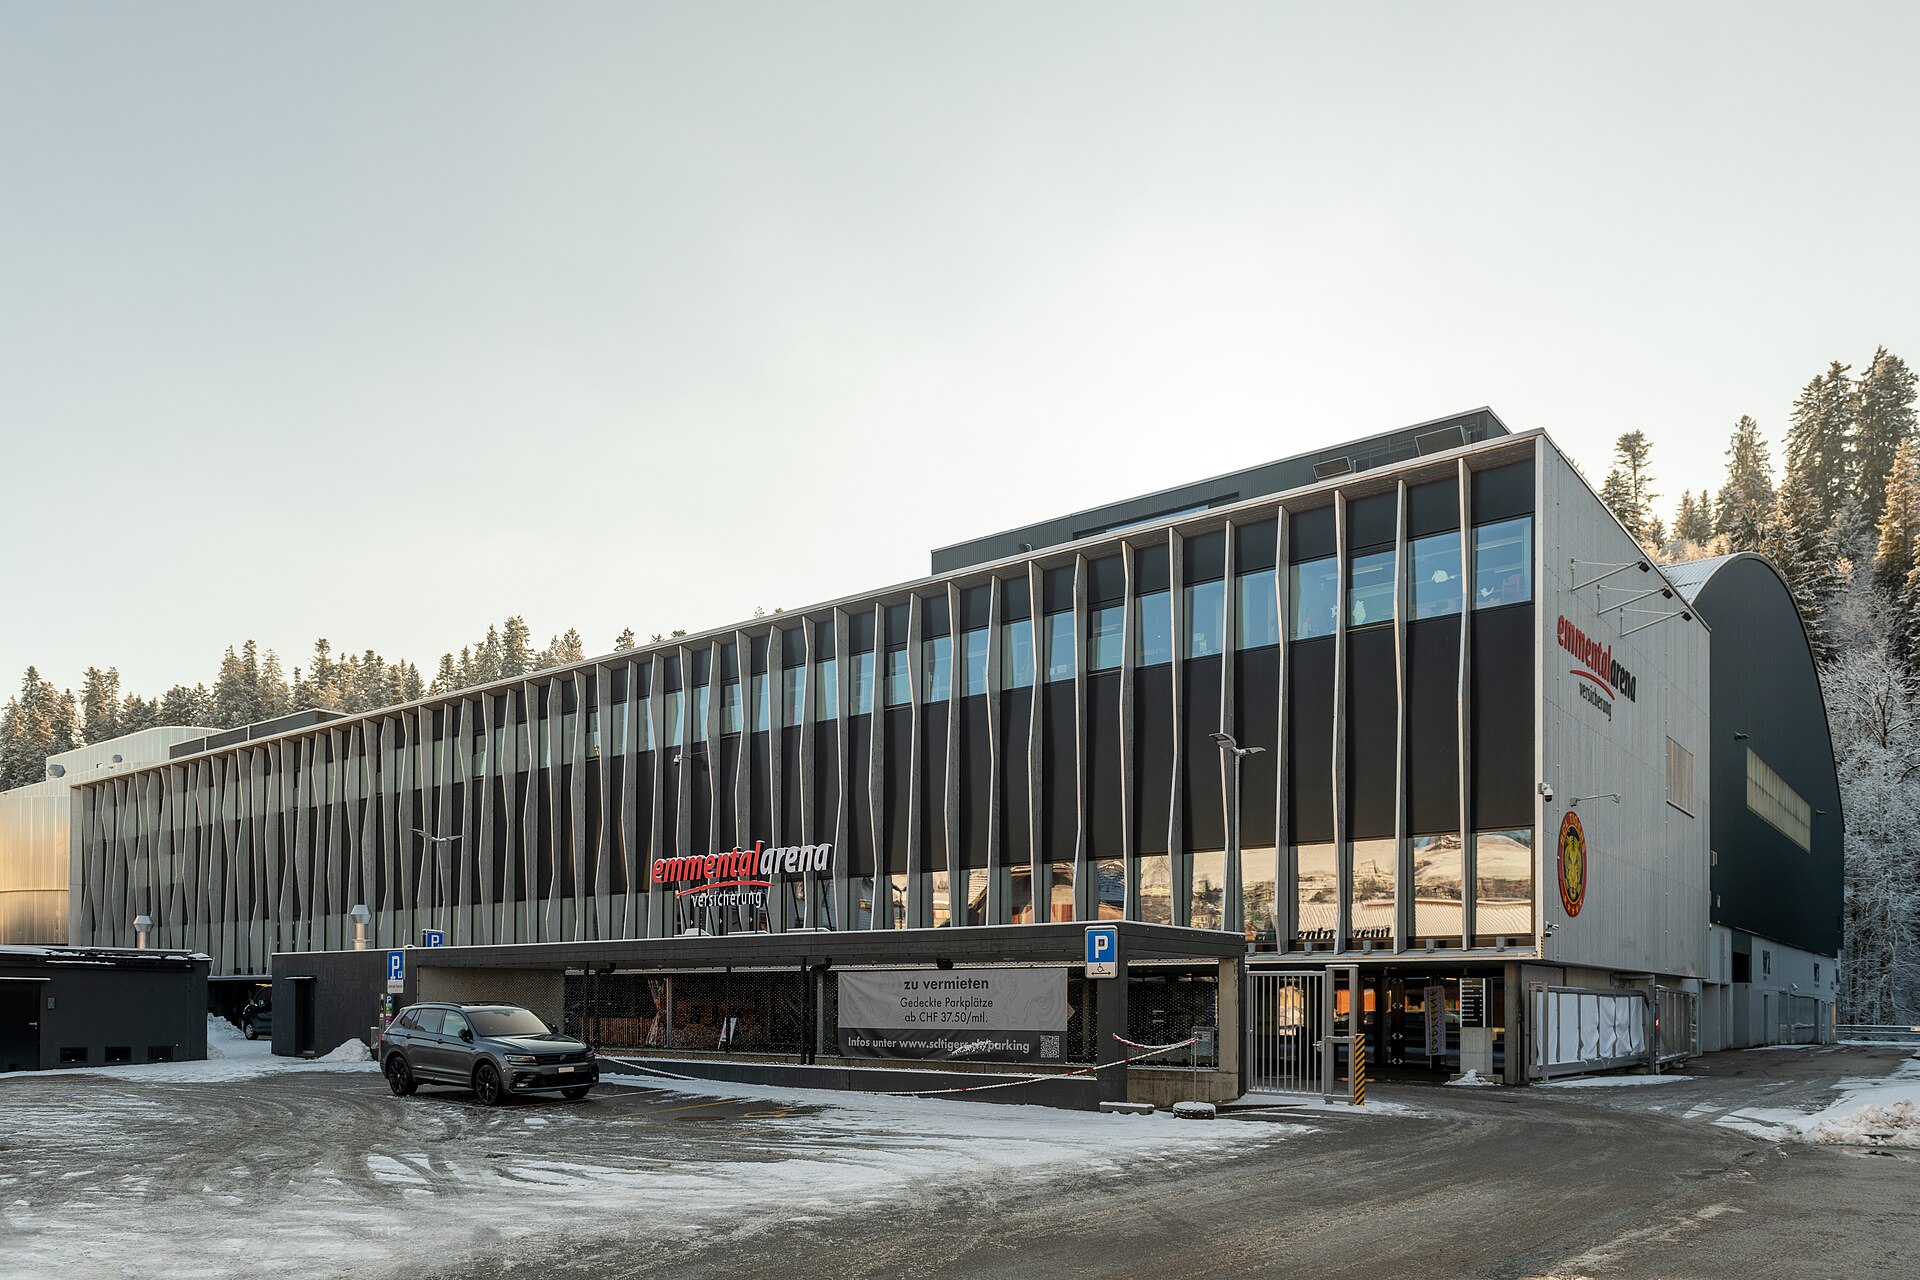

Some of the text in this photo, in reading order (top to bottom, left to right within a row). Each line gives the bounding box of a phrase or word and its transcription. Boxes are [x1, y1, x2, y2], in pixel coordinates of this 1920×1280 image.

[1557, 615, 1636, 703] emmentalarena
[1579, 682, 1611, 721] versicherung
[652, 840, 831, 883] emmentalarena
[691, 889, 762, 909] versicherung
[1095, 935, 1108, 959] P
[391, 955, 399, 979] P
[904, 976, 989, 990] zu vermieten
[900, 997, 993, 1010] Gedeckte Parkplätze
[905, 1011, 988, 1024] ab CHF 37.50/mtl.
[848, 1036, 1030, 1053] Infos unter www.scltigersh/parking
